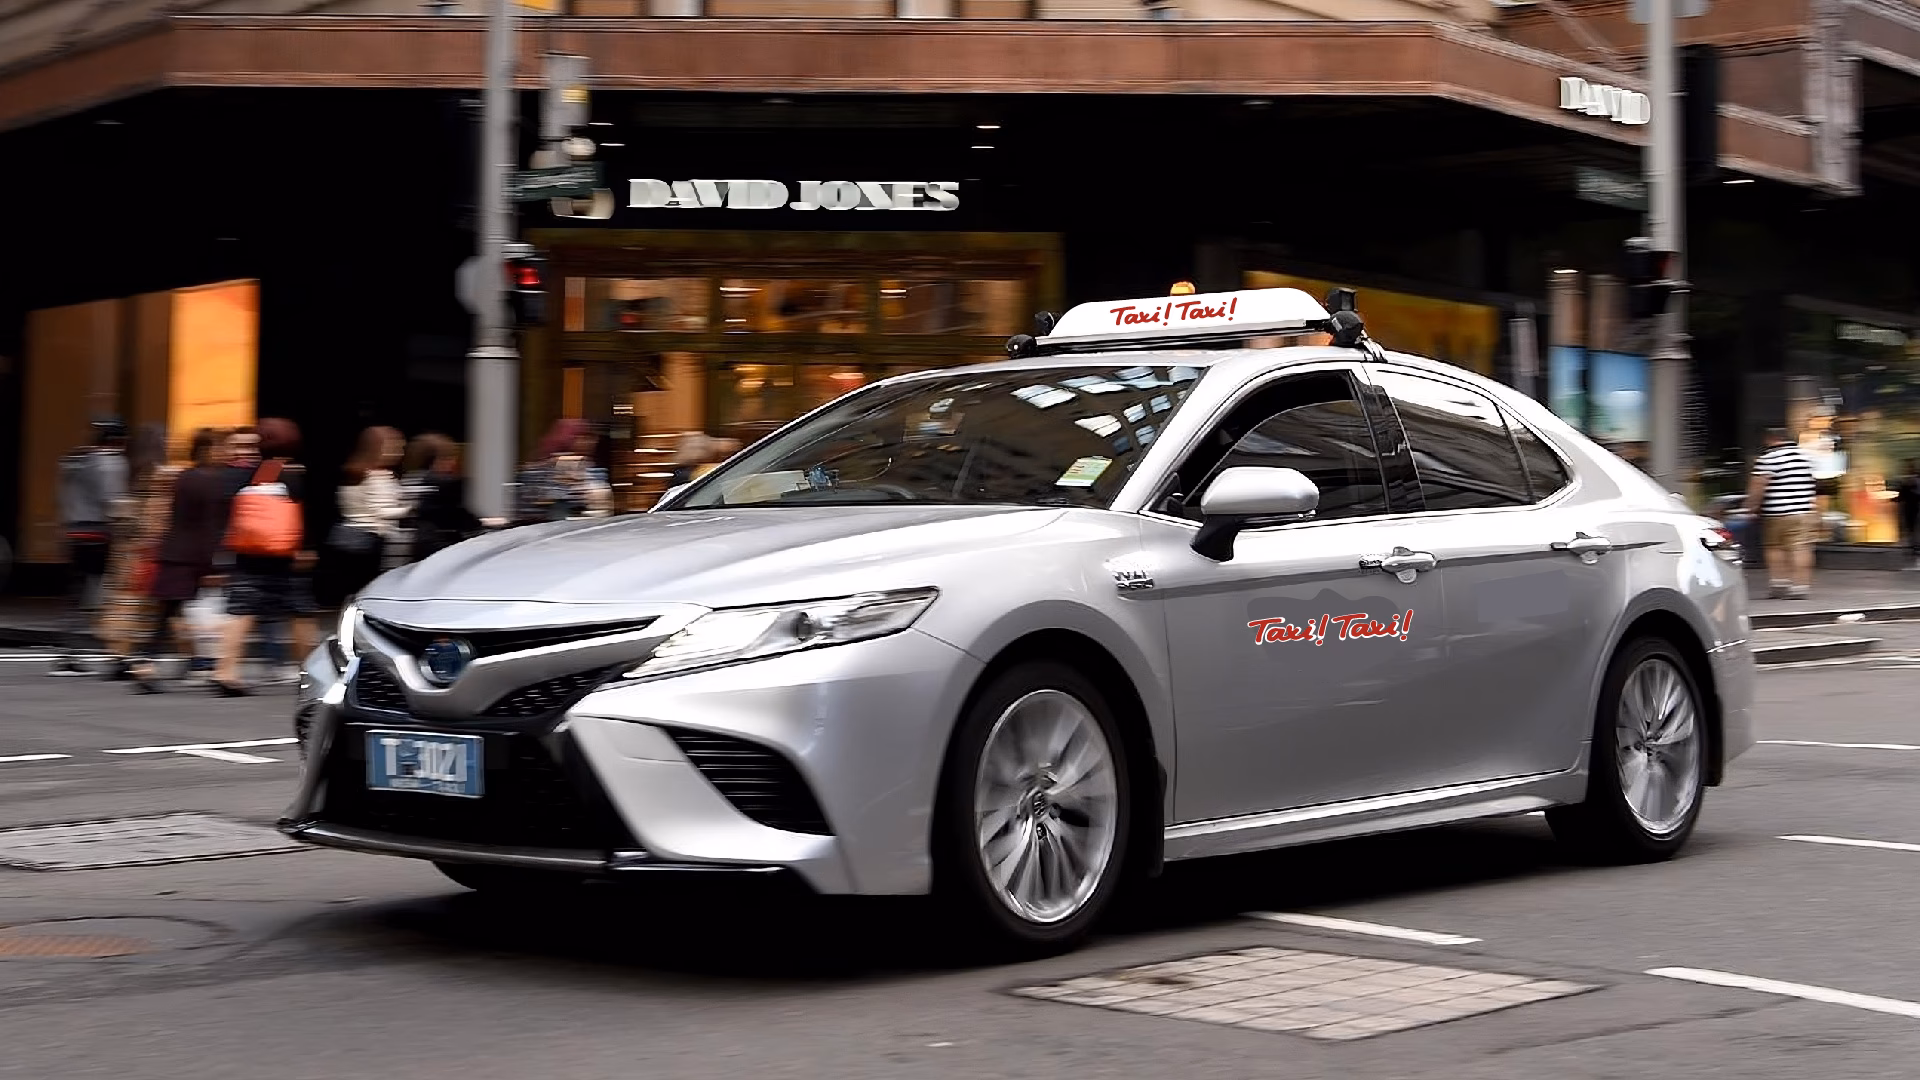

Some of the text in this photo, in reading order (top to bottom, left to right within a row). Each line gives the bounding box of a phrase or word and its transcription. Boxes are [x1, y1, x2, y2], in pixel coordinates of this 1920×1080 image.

[1559, 77, 1651, 124] DAVID
[627, 178, 789, 209] DAVID
[789, 180, 960, 211] JONES
[1110, 297, 1237, 326] Taxi! Taxi!
[1247, 608, 1414, 646] Taxi! Taxi!
